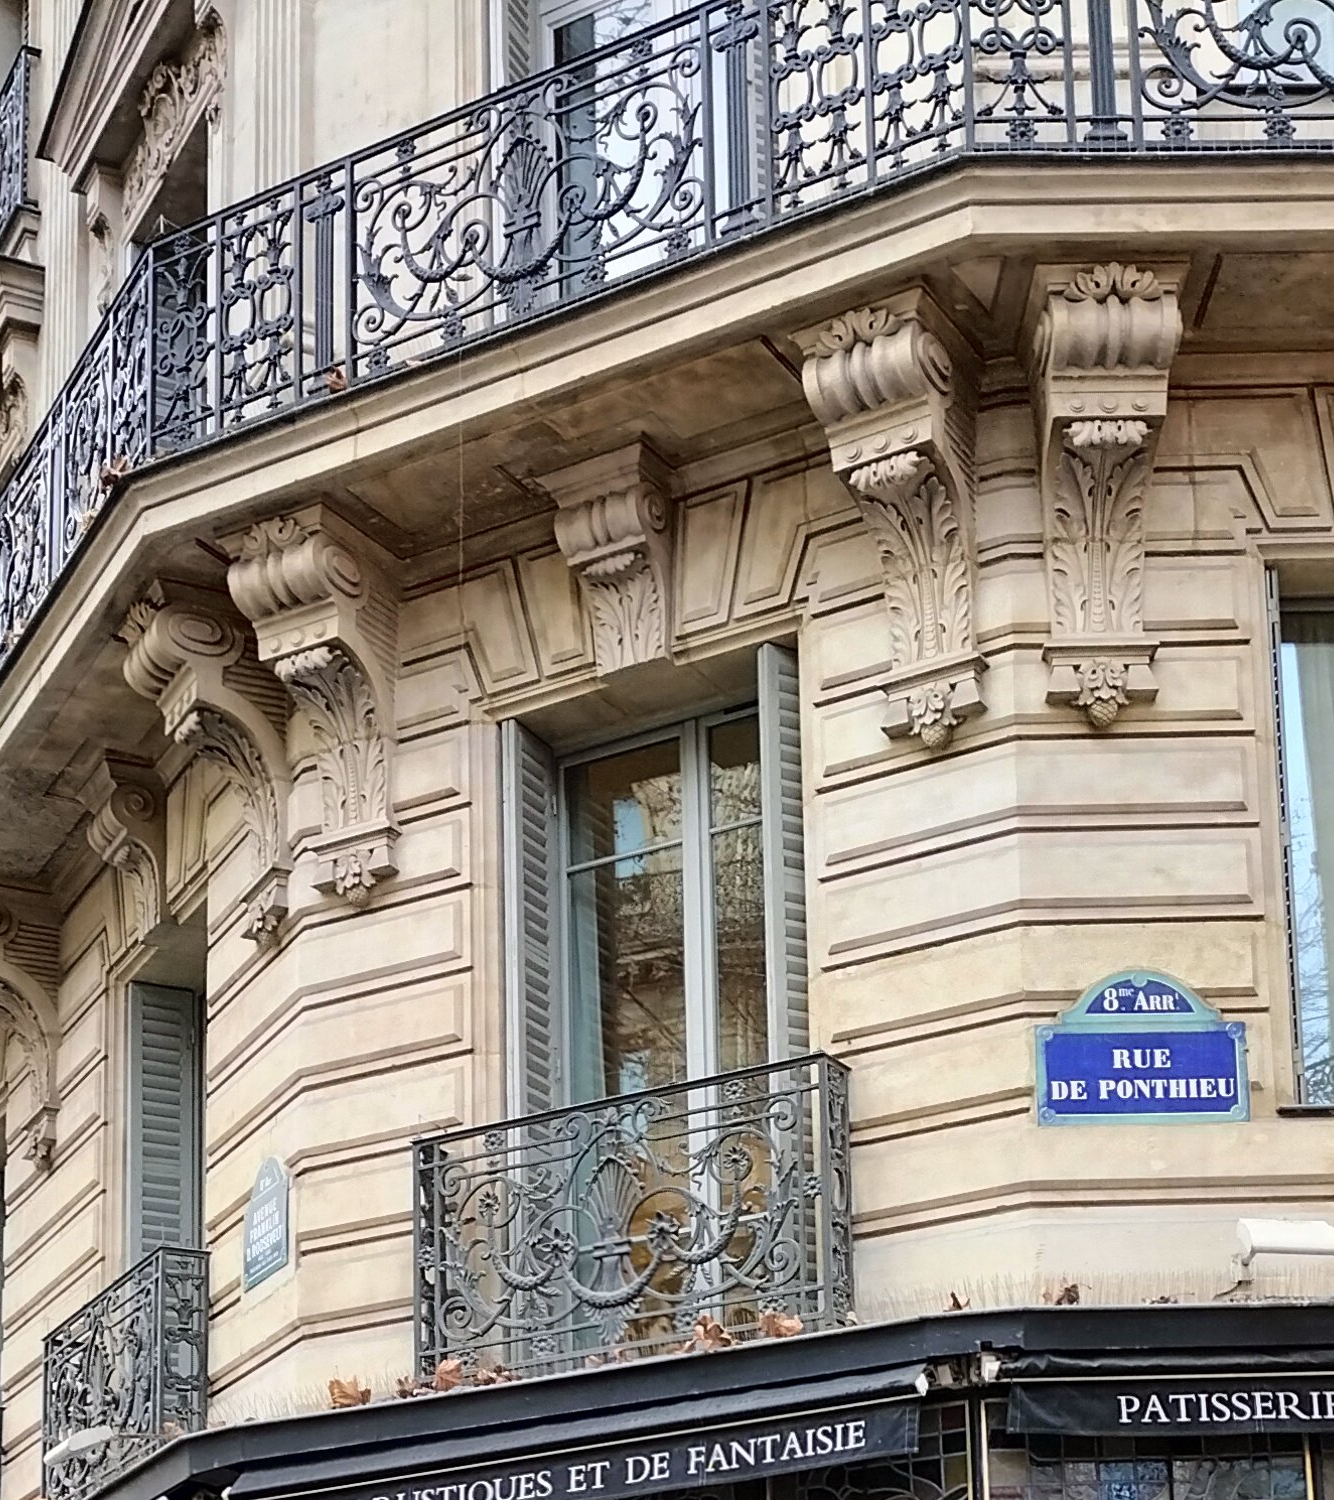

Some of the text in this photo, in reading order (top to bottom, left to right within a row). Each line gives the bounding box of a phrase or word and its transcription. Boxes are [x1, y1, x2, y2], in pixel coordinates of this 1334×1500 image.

[1112, 1048, 1172, 1069] RUE
[1050, 1077, 1235, 1100] DE PONTHIEU
[566, 1462, 610, 1493] ET
[624, 1452, 671, 1485] DE
[685, 1419, 867, 1474] FANTAISIE
